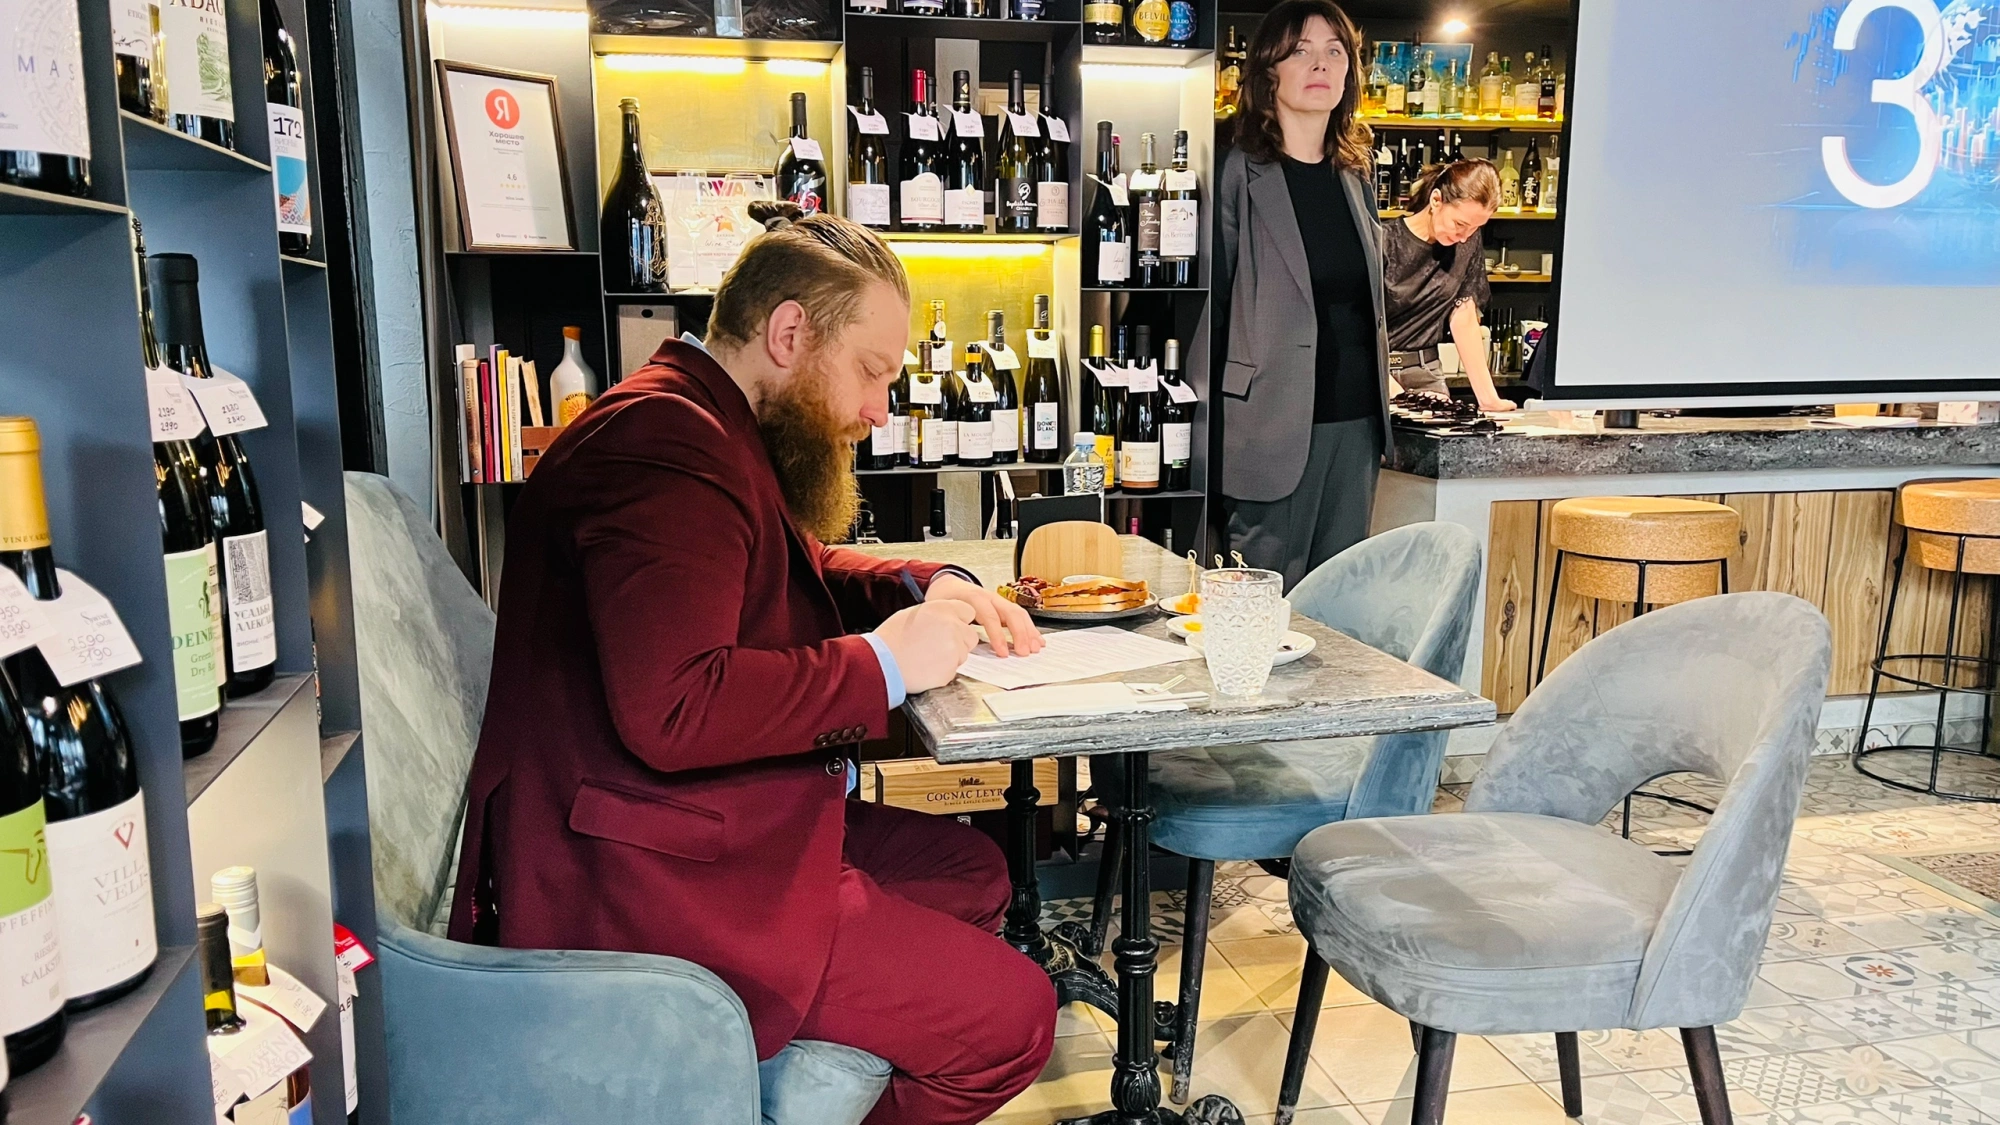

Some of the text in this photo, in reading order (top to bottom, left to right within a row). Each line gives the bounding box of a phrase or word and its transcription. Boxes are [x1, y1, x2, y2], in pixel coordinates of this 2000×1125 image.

[1822, 0, 1943, 209] 3
[273, 117, 302, 139] 172
[489, 131, 525, 141] Хорошее
[495, 138, 520, 146] место
[68, 633, 105, 652] 2590
[927, 790, 973, 802] COGNAC
